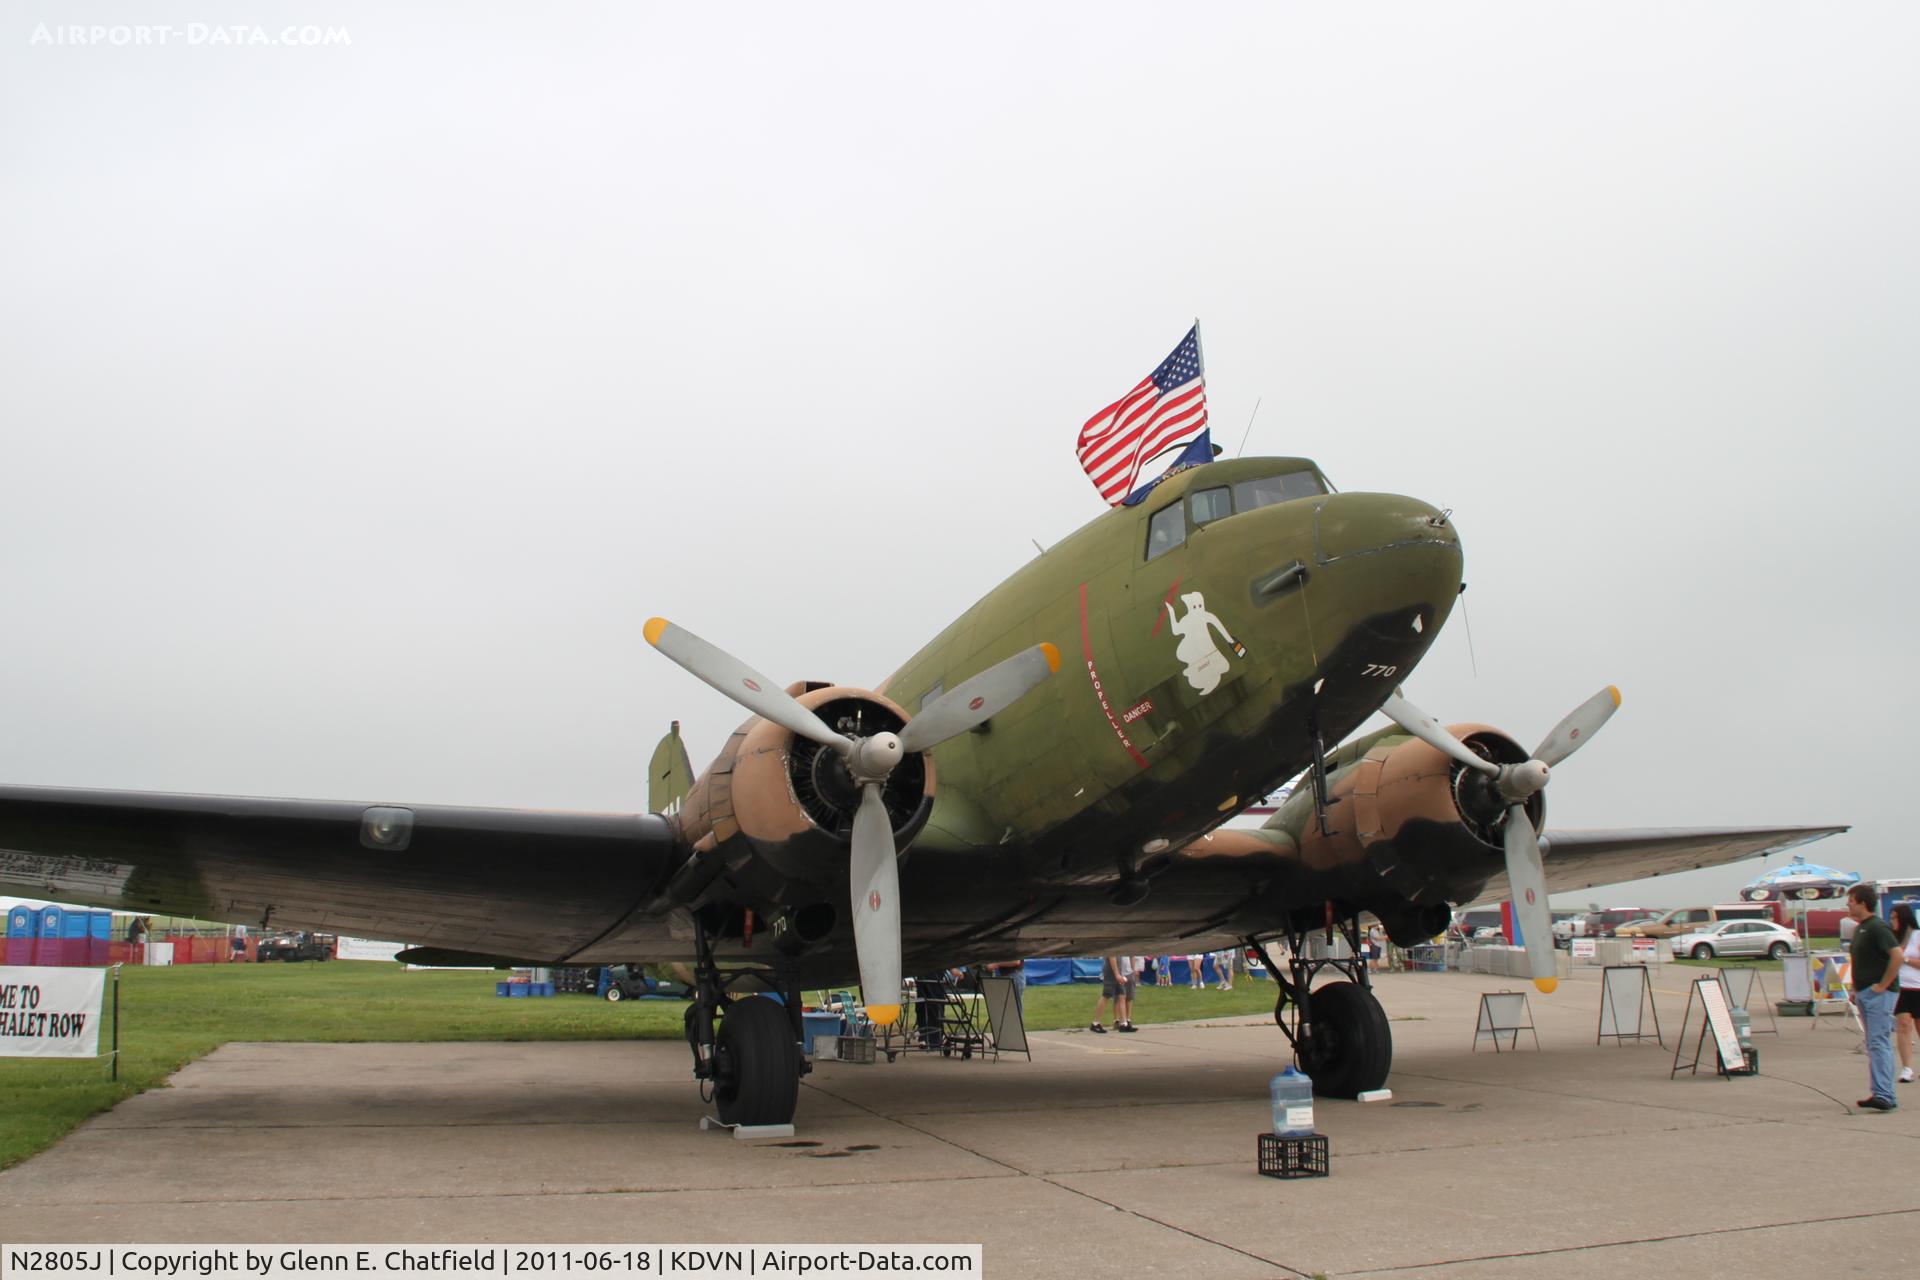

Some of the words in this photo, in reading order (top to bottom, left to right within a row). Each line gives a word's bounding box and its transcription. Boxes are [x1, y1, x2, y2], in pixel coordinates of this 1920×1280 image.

[1361, 664, 1397, 677] 770
[1087, 661, 1131, 747] PROPELLER
[1123, 701, 1152, 723] DANGER
[773, 916, 787, 937] 770
[20, 985, 40, 1009] TO
[49, 1013, 86, 1038] ROW
